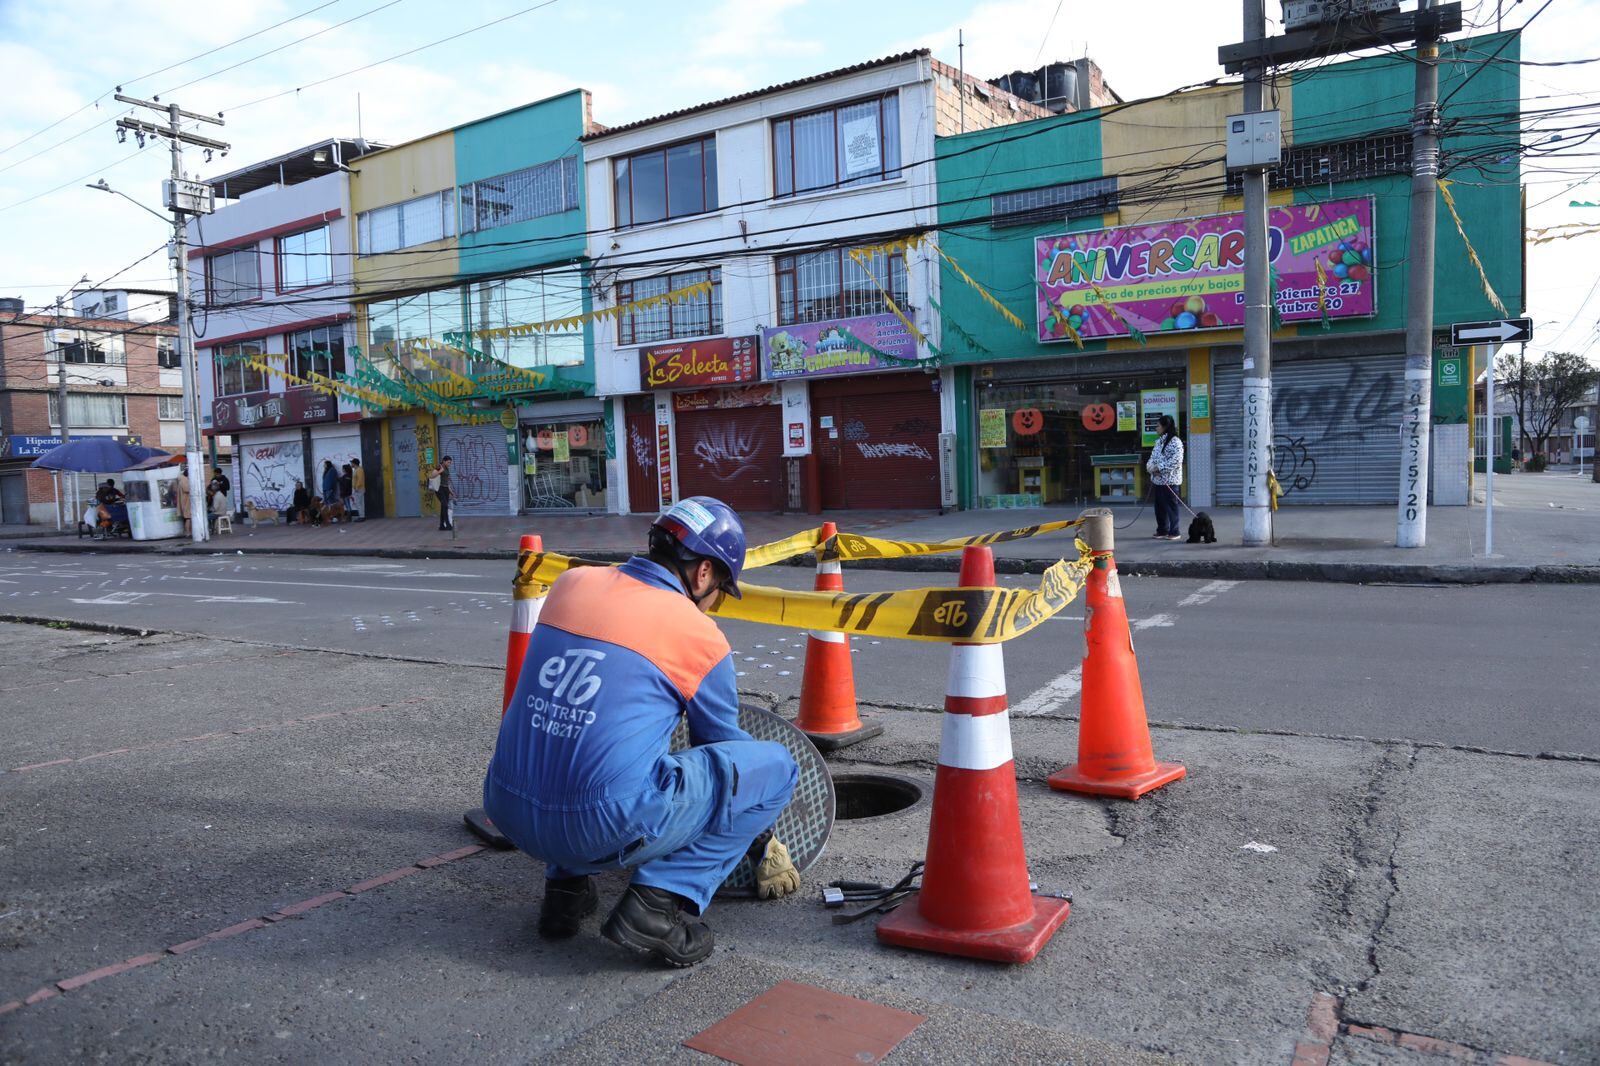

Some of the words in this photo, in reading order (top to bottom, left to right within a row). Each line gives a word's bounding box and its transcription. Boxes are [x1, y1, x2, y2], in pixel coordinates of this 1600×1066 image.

[1120, 288, 1133, 299] de
[1135, 283, 1177, 300] precios
[1180, 281, 1206, 298] muy
[1208, 276, 1240, 294] bajos
[1340, 283, 1359, 295] 27
[1324, 298, 1343, 310] 20
[647, 352, 669, 387] La
[667, 348, 728, 382] Selecta
[19, 446, 31, 454] La
[1248, 394, 1259, 497] CUADRANTE
[526, 694, 597, 725] CONTRATO
